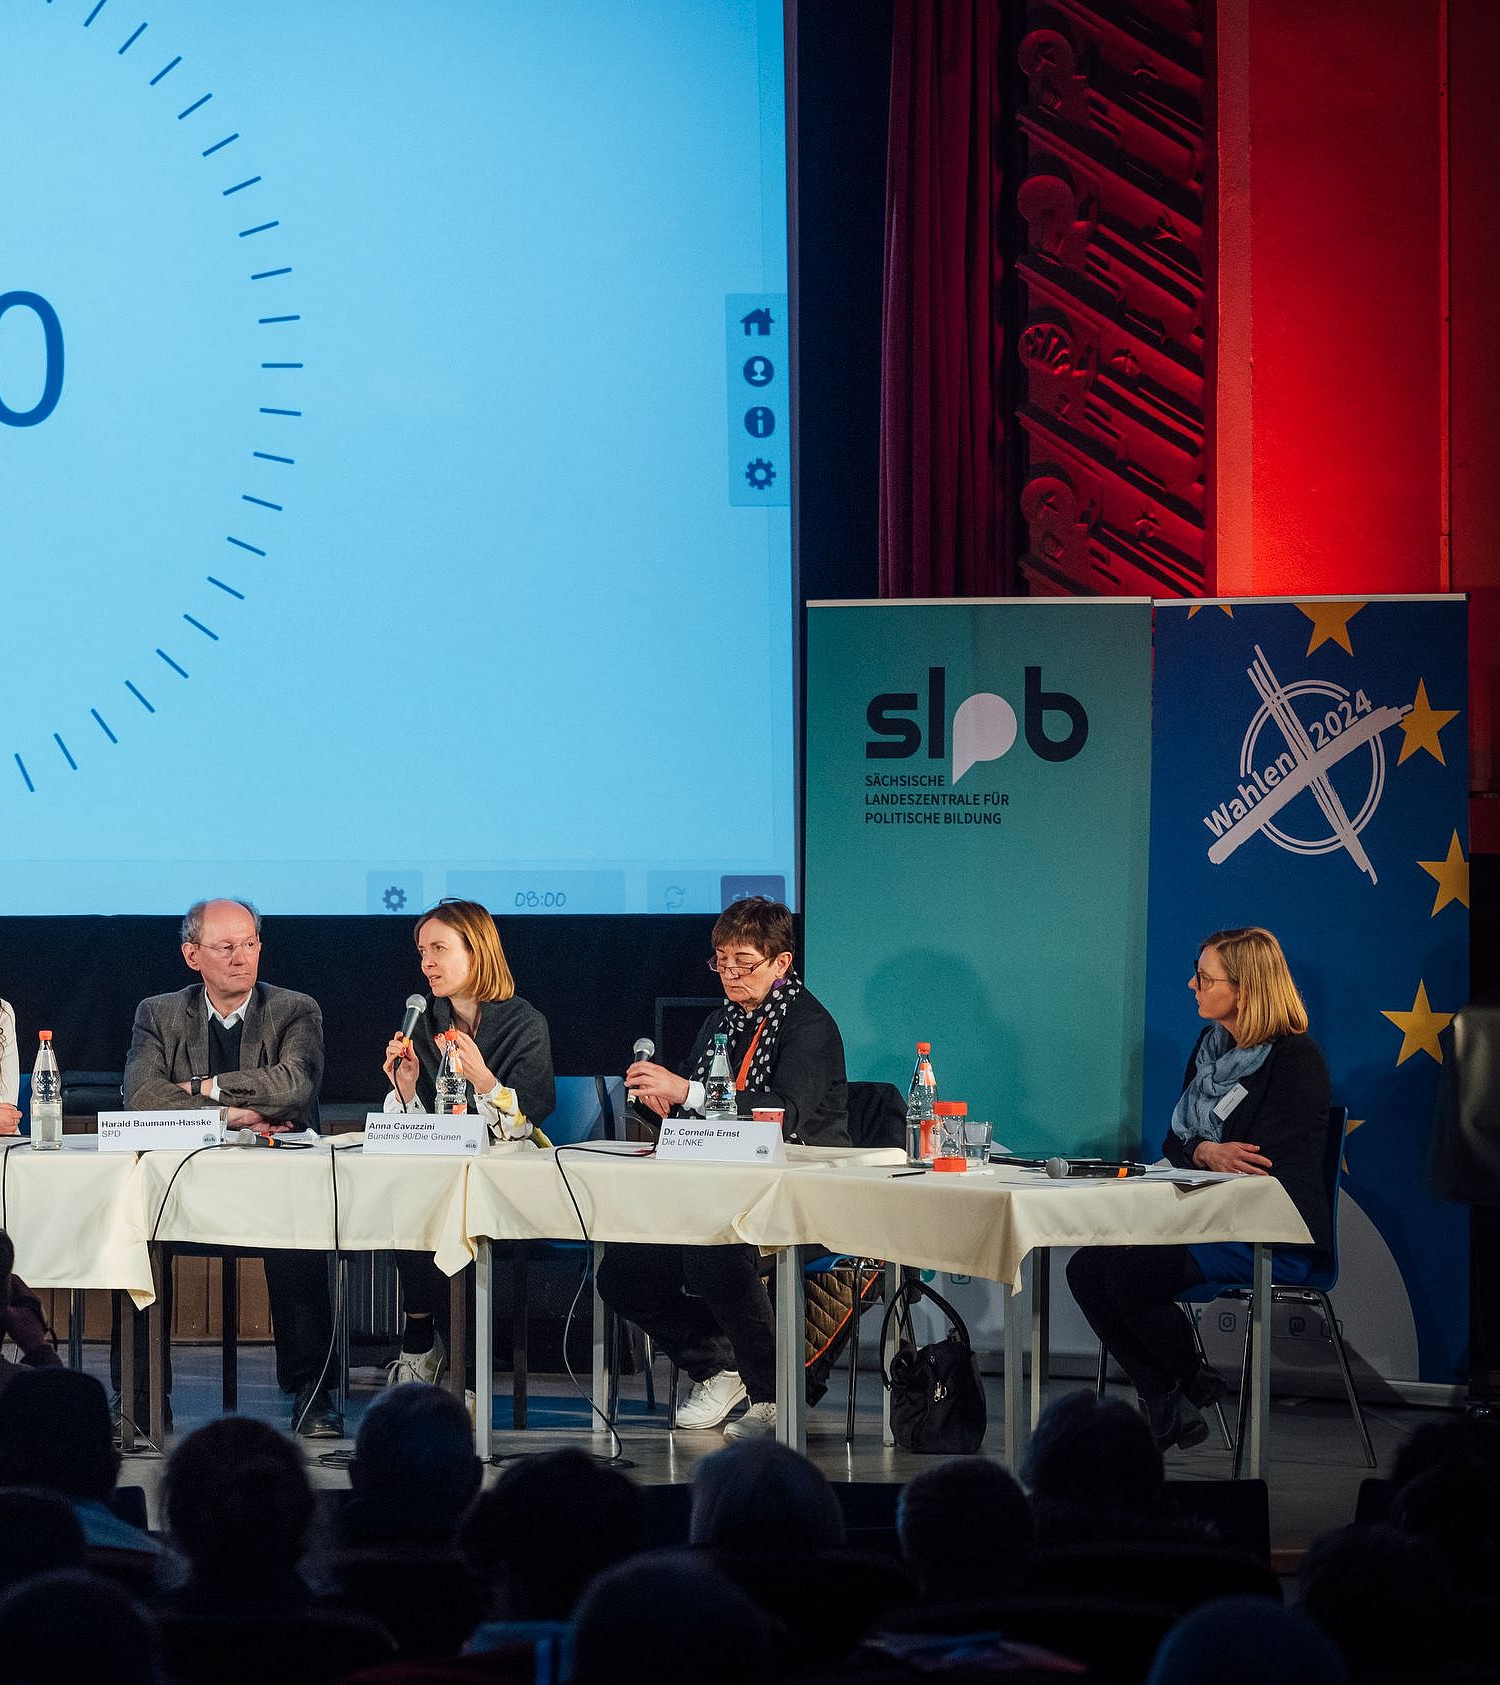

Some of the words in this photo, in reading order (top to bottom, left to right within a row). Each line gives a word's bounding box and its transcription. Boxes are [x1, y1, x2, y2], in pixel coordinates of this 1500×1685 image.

[865, 666, 1089, 786] slpb
[1203, 751, 1297, 838] Wahlen
[1308, 689, 1372, 749] 2024
[865, 772, 945, 787] SÄCHSISCHE
[865, 793, 980, 806] LANDESZENTRALE
[983, 791, 1009, 806] FÜR
[865, 812, 940, 825] POLITISCHE
[944, 812, 1002, 825] BILDUNG
[514, 891, 567, 908] 08:00
[101, 1120, 131, 1128] Harald
[133, 1119, 212, 1128] Baumann-Hasske
[368, 1122, 392, 1130] Anna
[393, 1122, 436, 1131] Cavazzini
[101, 1130, 121, 1138] SPD
[663, 1128, 676, 1136] Dr.
[678, 1128, 715, 1137] Cornelia
[716, 1129, 740, 1138] Ernst
[661, 1137, 676, 1146] Die
[677, 1138, 704, 1147] LINKE
